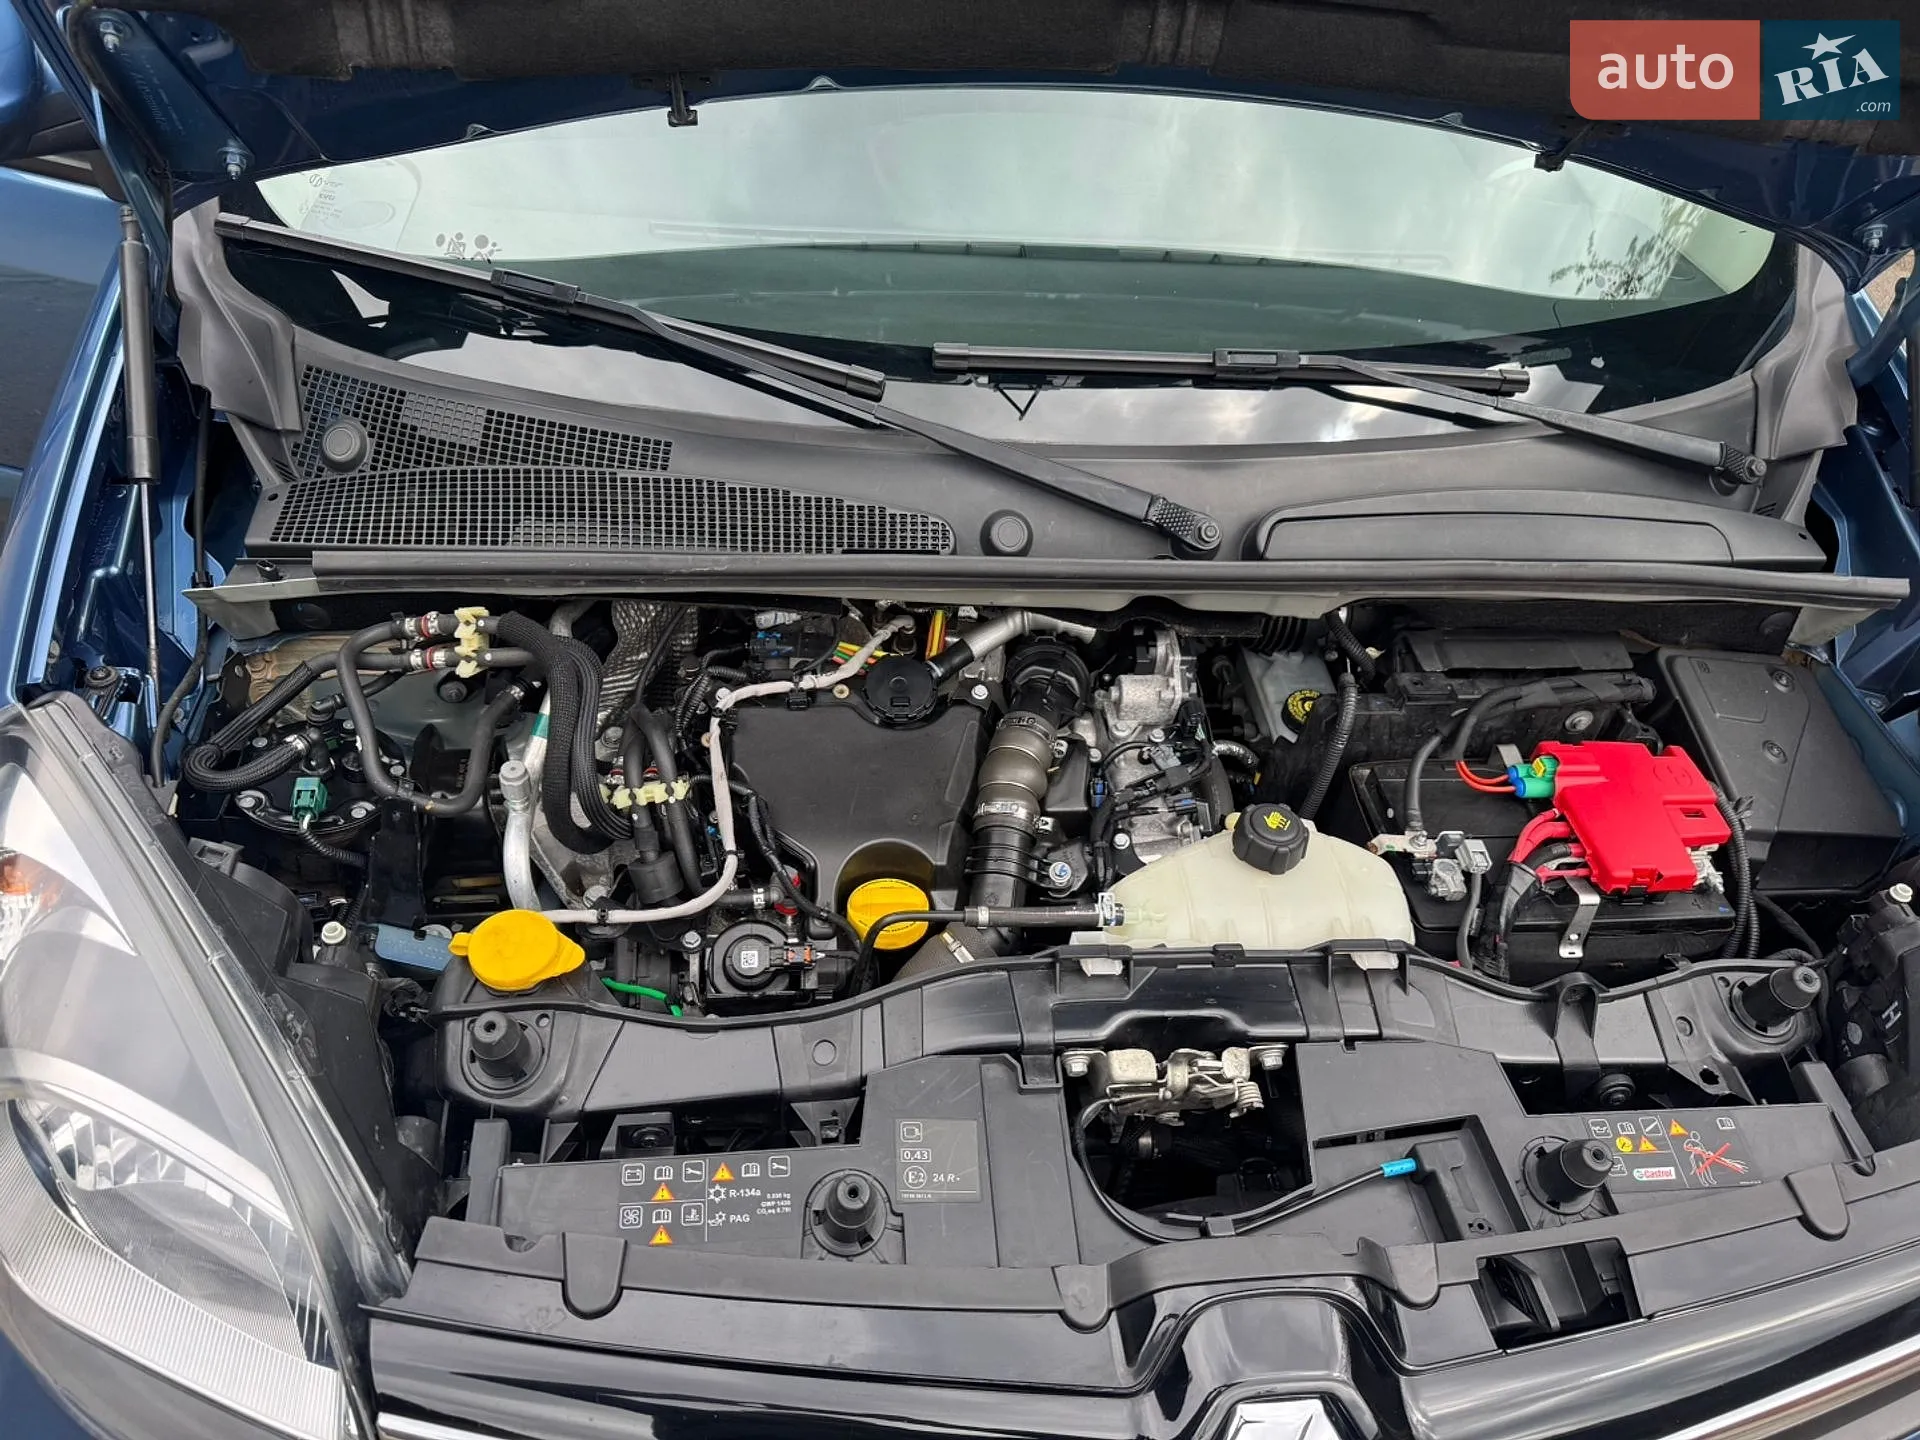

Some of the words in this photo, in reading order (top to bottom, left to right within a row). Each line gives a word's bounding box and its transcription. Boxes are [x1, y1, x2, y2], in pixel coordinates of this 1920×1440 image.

[904, 1150, 929, 1161] 0,43
[932, 1173, 945, 1182] 24
[1643, 1168, 1674, 1179] Castrol
[729, 1187, 762, 1199] R-134a
[729, 1213, 751, 1224] PAG
